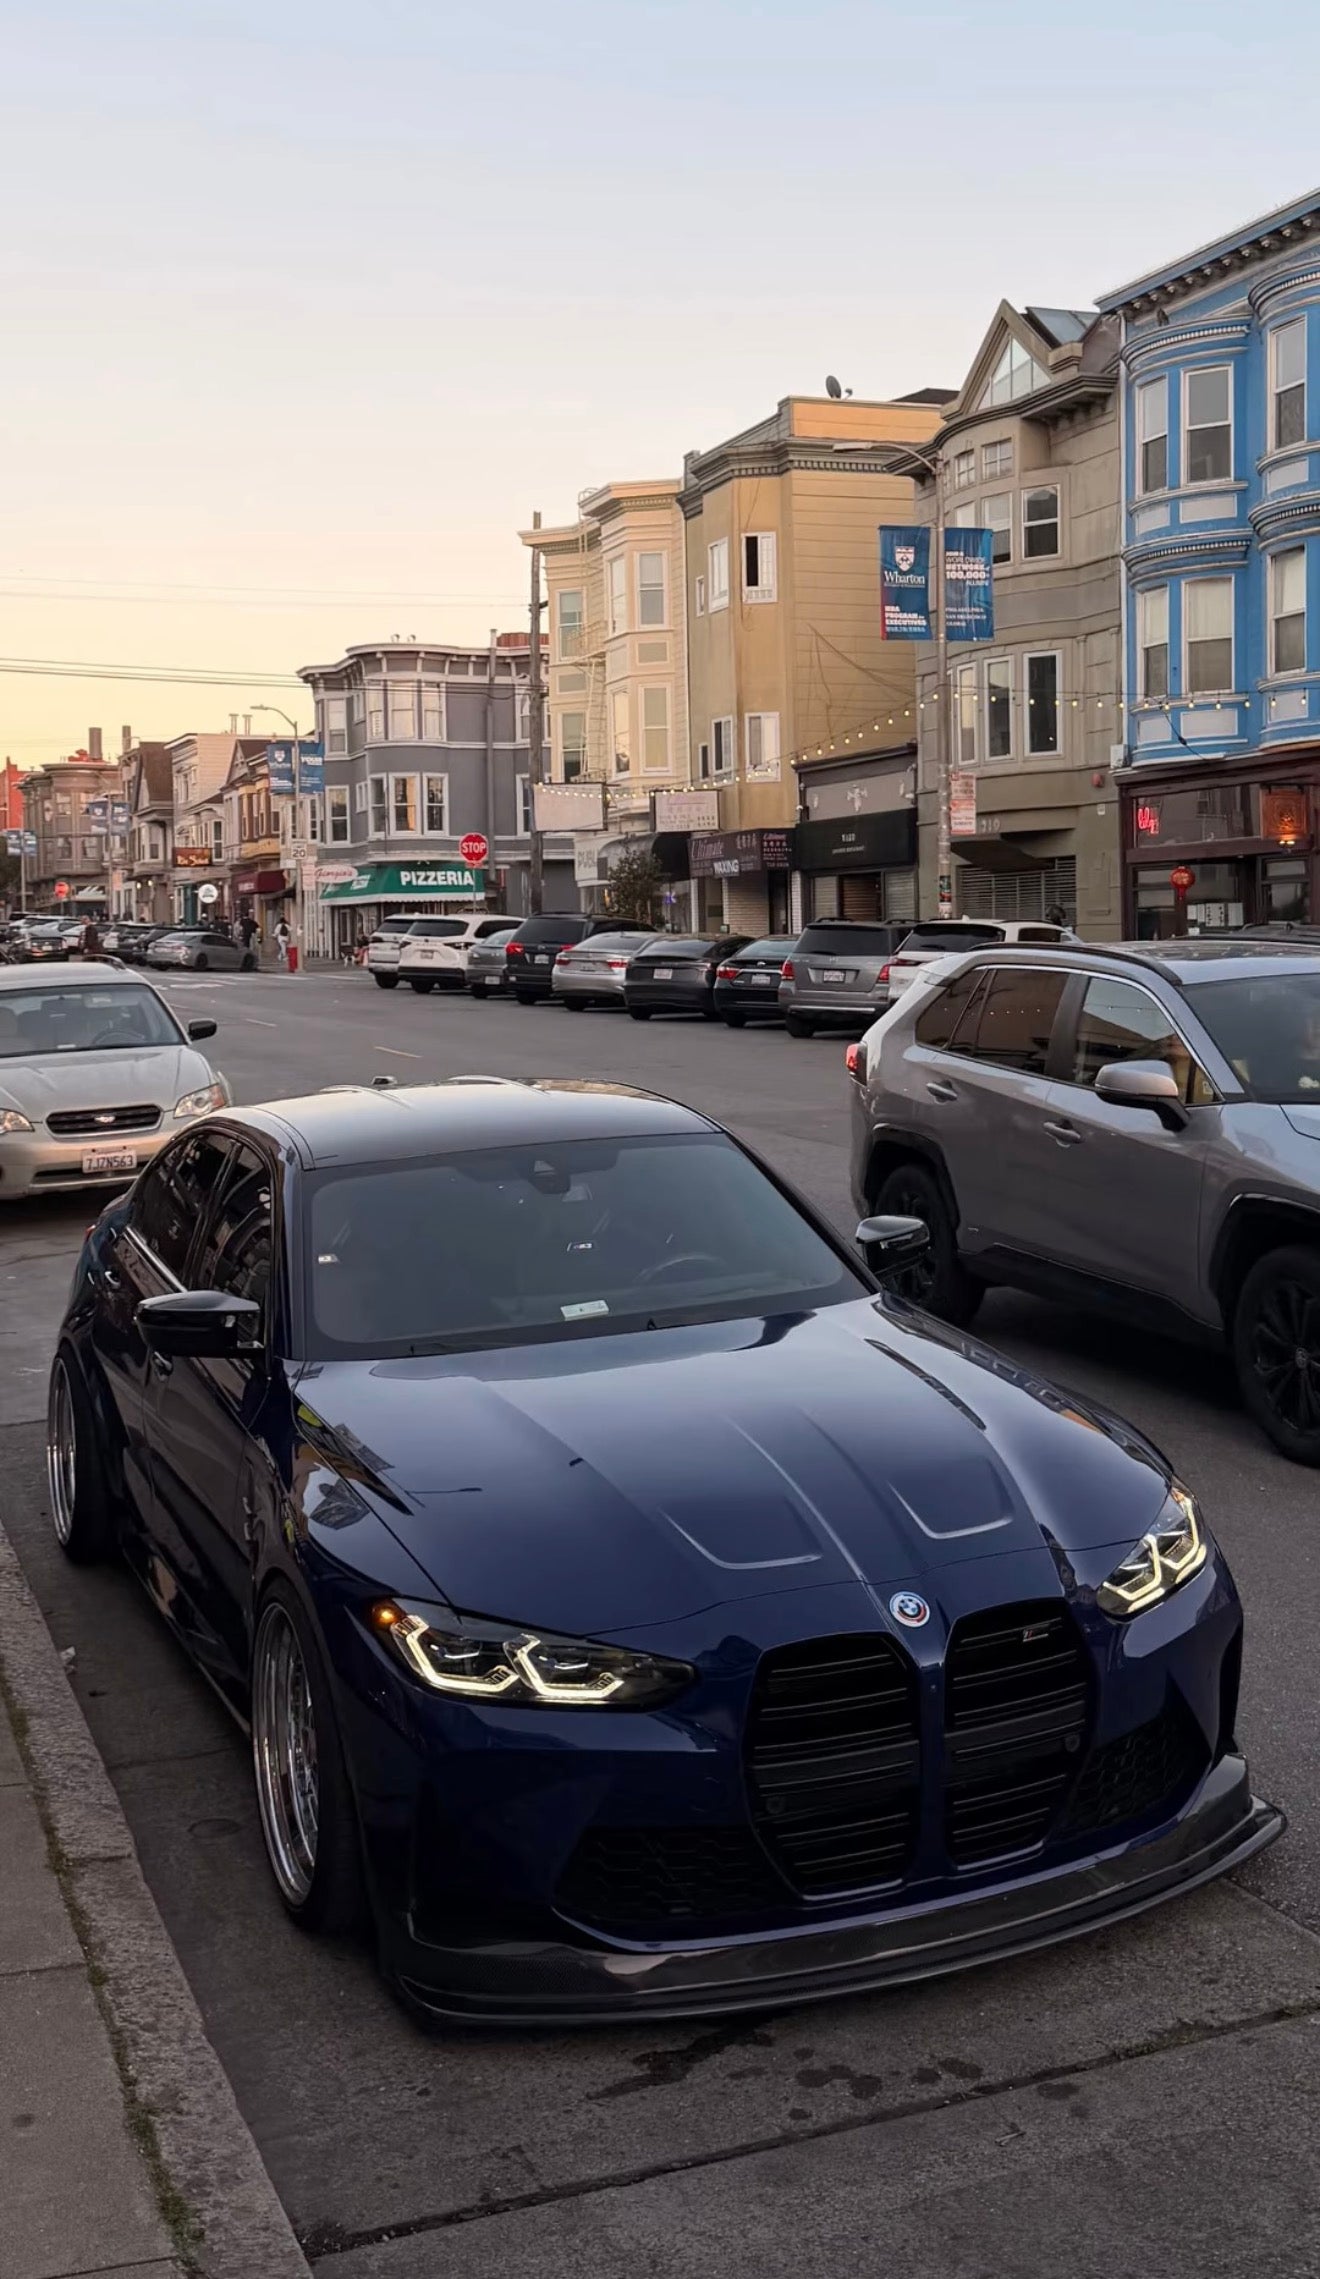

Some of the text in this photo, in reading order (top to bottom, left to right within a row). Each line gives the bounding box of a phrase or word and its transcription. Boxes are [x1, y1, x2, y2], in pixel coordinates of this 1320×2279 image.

[884, 570, 925, 585] Wharton
[292, 848, 306, 857] 20
[462, 842, 486, 853] STOP
[713, 859, 739, 874] WAXING
[400, 870, 474, 886] PIZZERIA
